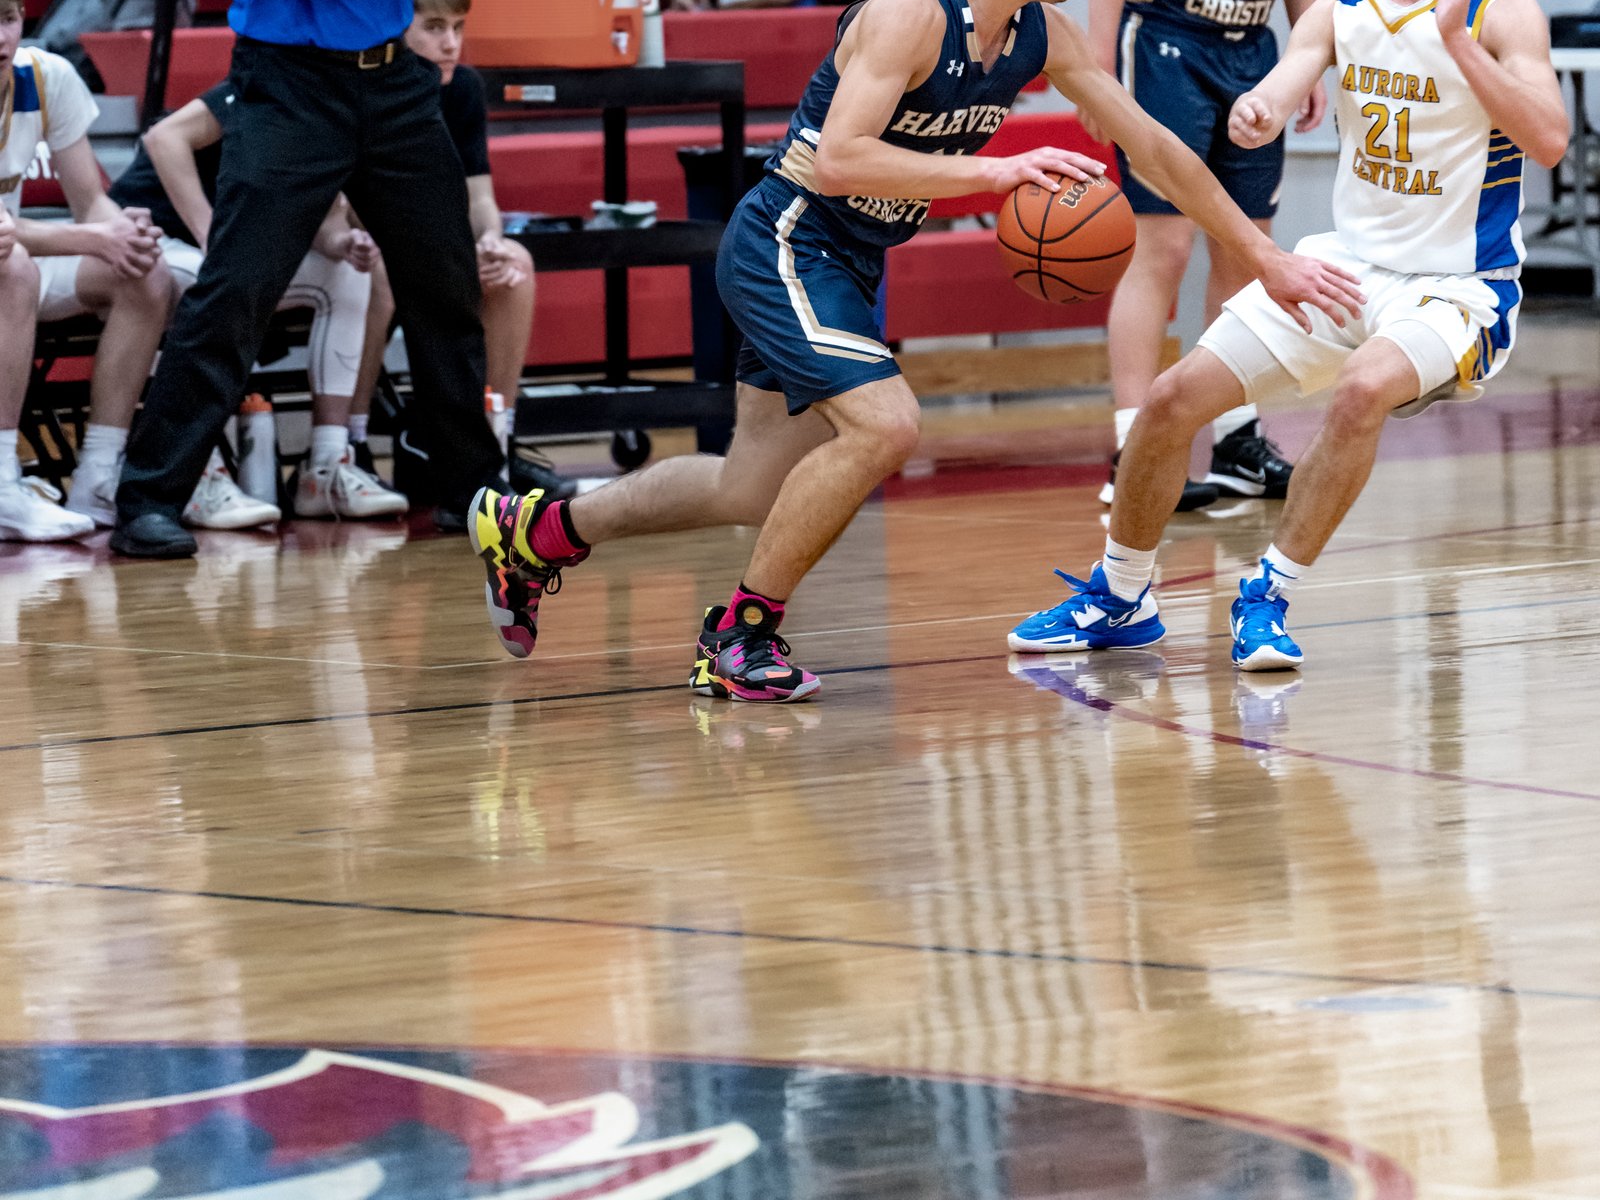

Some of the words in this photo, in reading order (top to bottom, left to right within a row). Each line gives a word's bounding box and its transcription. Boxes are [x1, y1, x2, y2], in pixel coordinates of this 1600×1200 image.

[1341, 64, 1440, 103] AURORA
[1361, 102, 1413, 162] 21
[1352, 146, 1442, 196] CENTRAL
